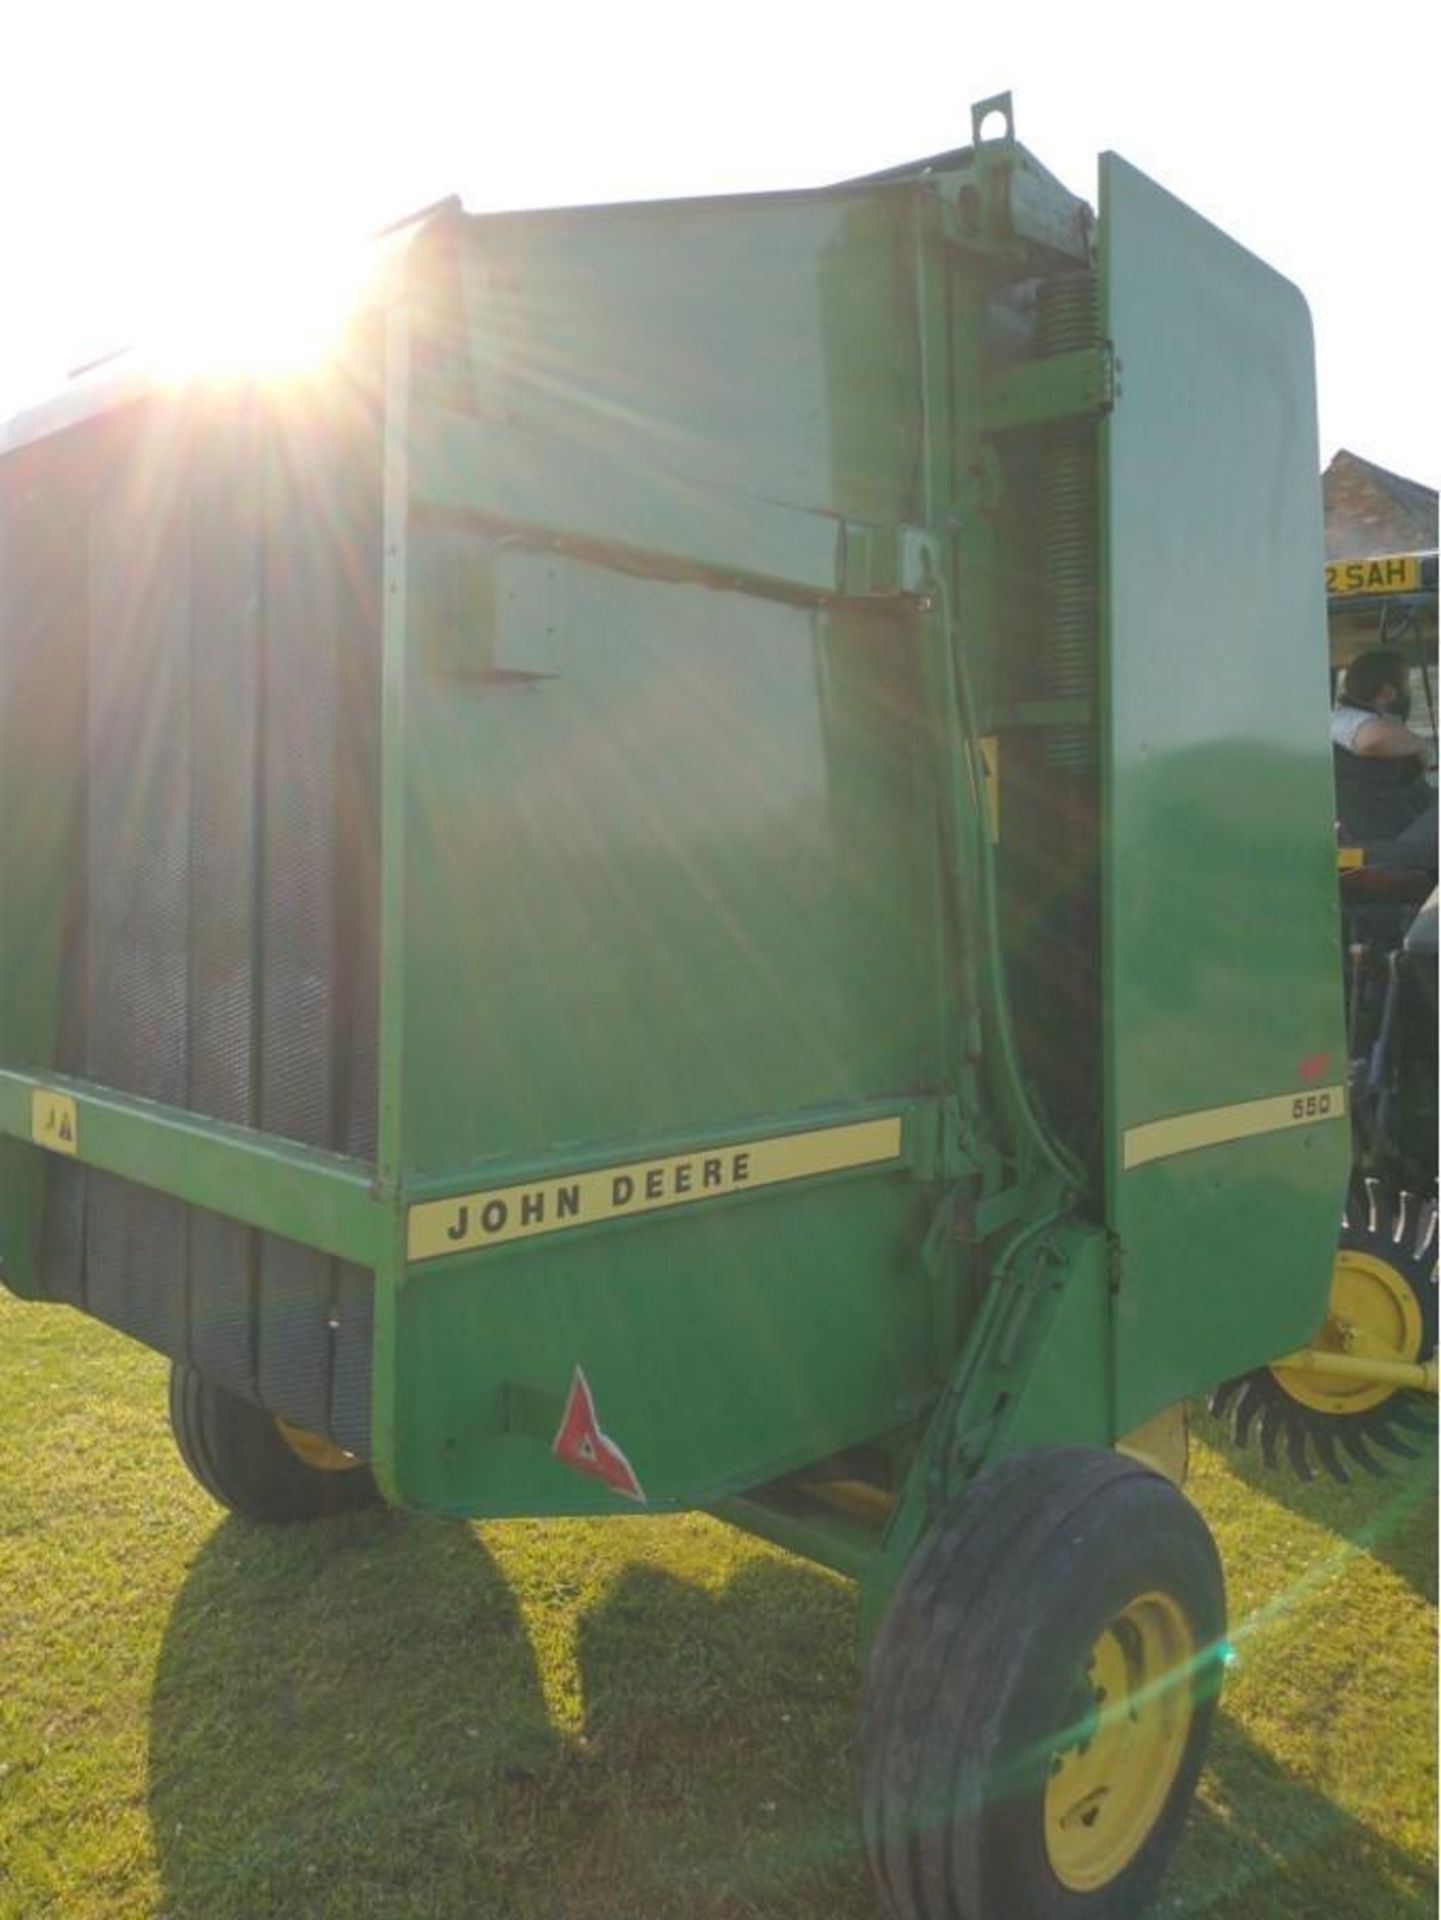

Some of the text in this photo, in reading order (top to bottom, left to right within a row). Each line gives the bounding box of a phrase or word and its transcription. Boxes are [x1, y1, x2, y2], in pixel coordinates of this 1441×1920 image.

[1346, 559, 1406, 588] SAH
[448, 1153, 749, 1239] JOHN DEERE
